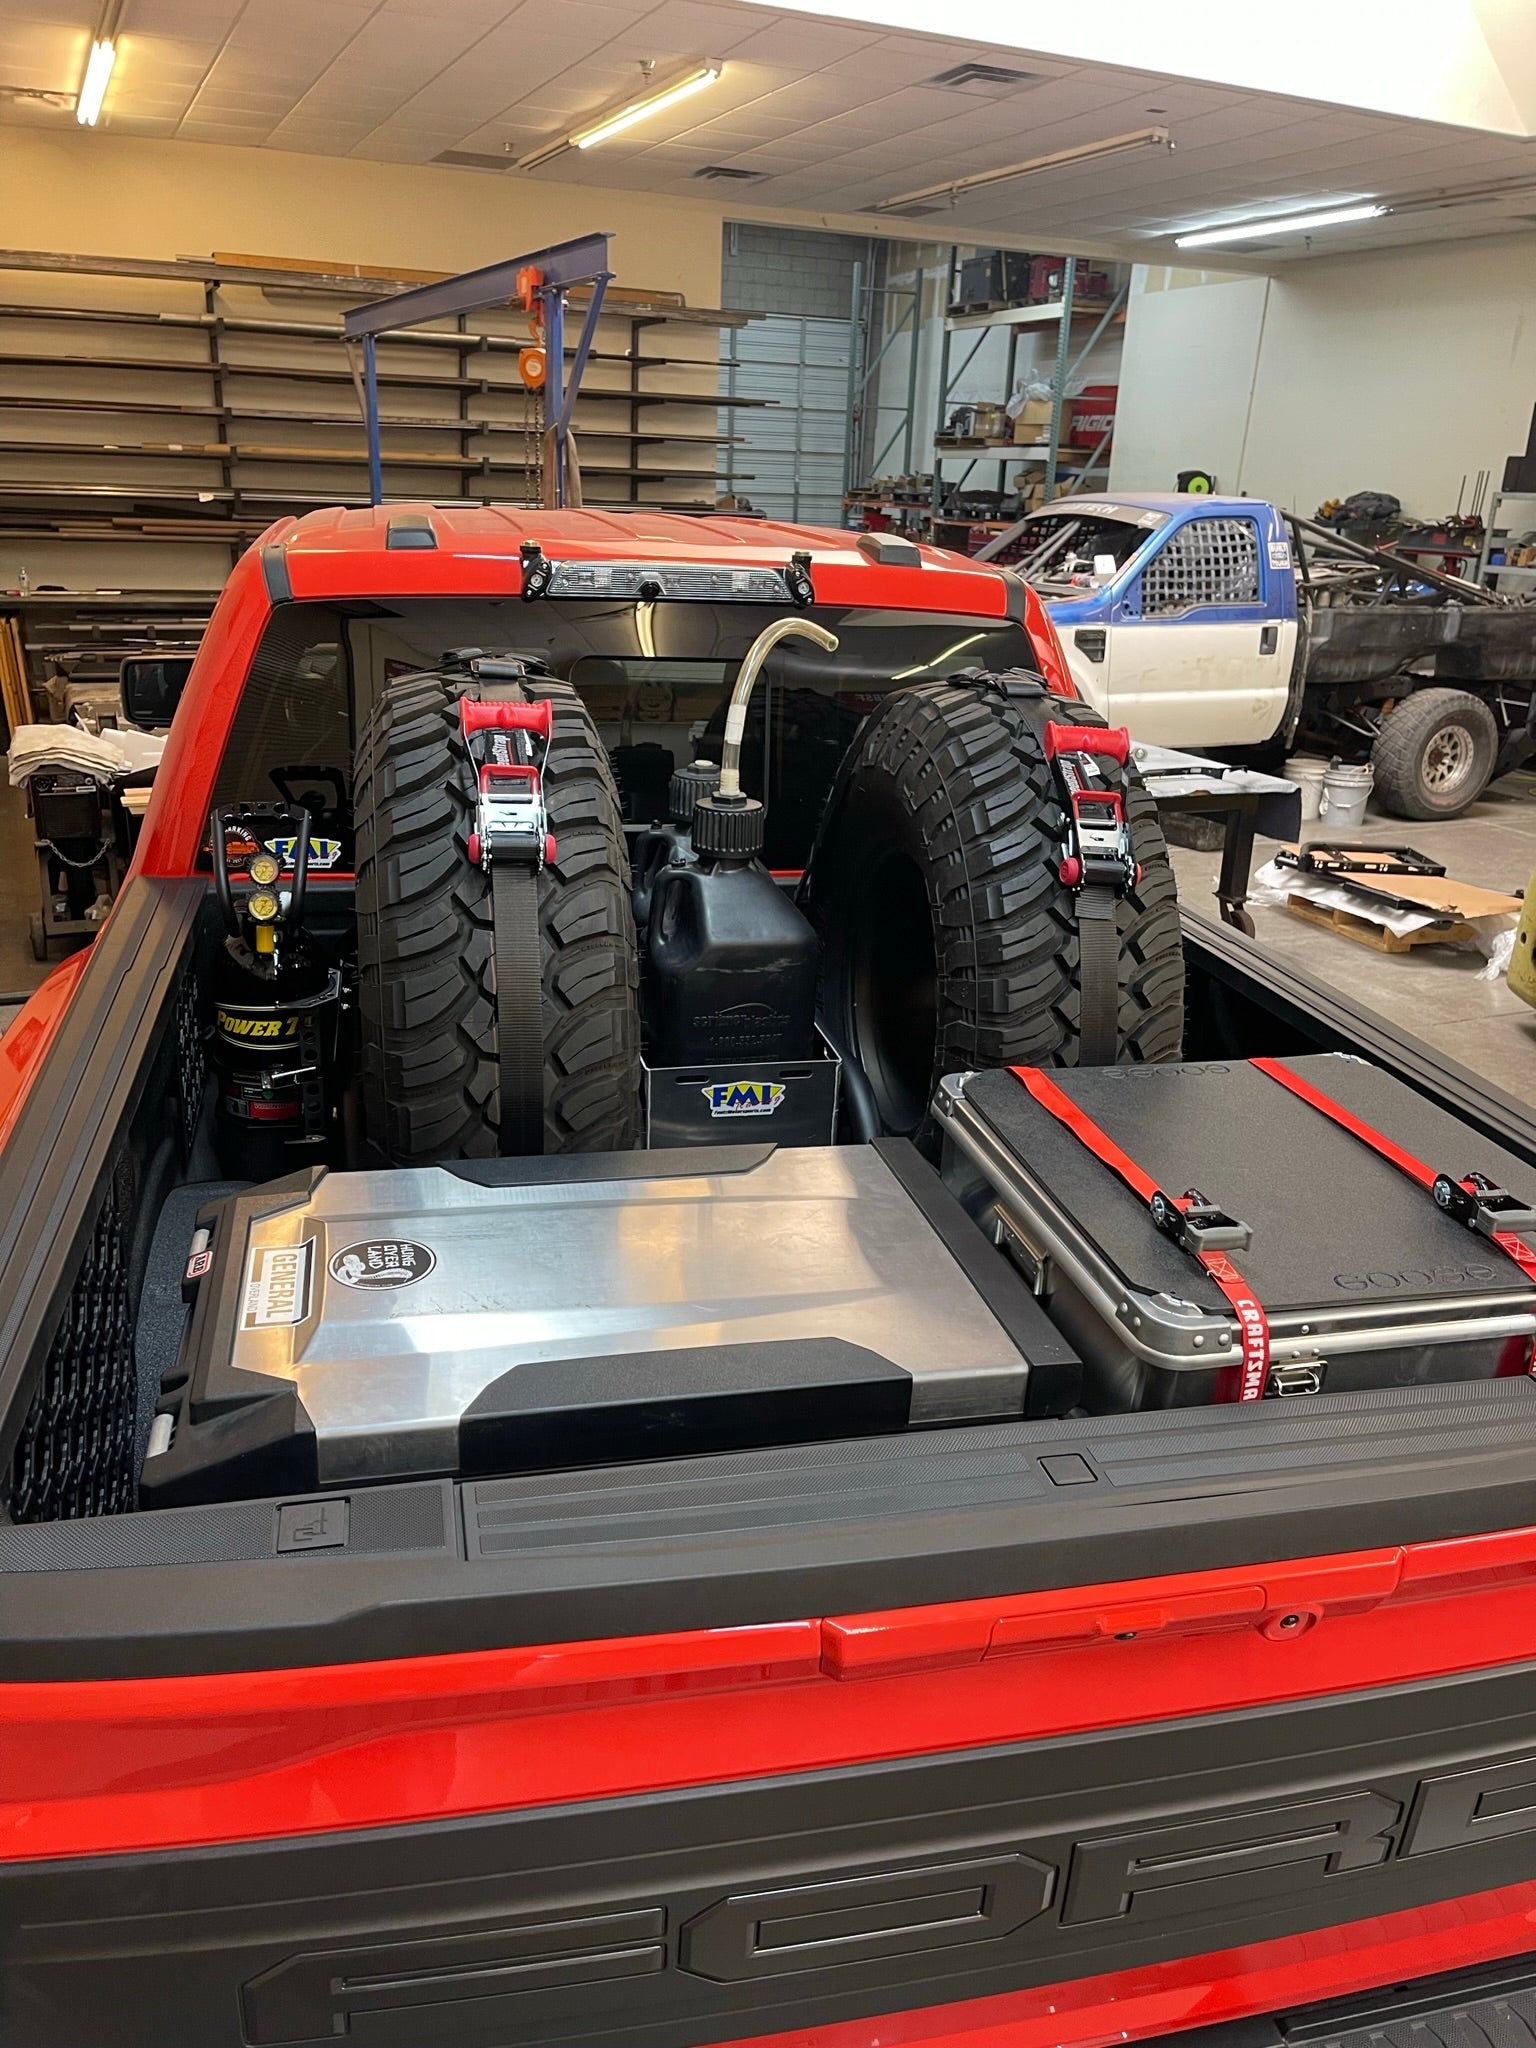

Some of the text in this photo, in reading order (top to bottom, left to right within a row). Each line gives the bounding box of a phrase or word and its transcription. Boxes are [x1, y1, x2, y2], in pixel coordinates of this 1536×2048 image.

[217, 1010, 282, 1037] POWER
[713, 1085, 771, 1107] FMI
[193, 1255, 206, 1273] ARB
[367, 1246, 384, 1269] LAND
[400, 1244, 416, 1266] HUNG
[247, 1282, 259, 1311] OVERLAND
[266, 1252, 298, 1318] GENERAL
